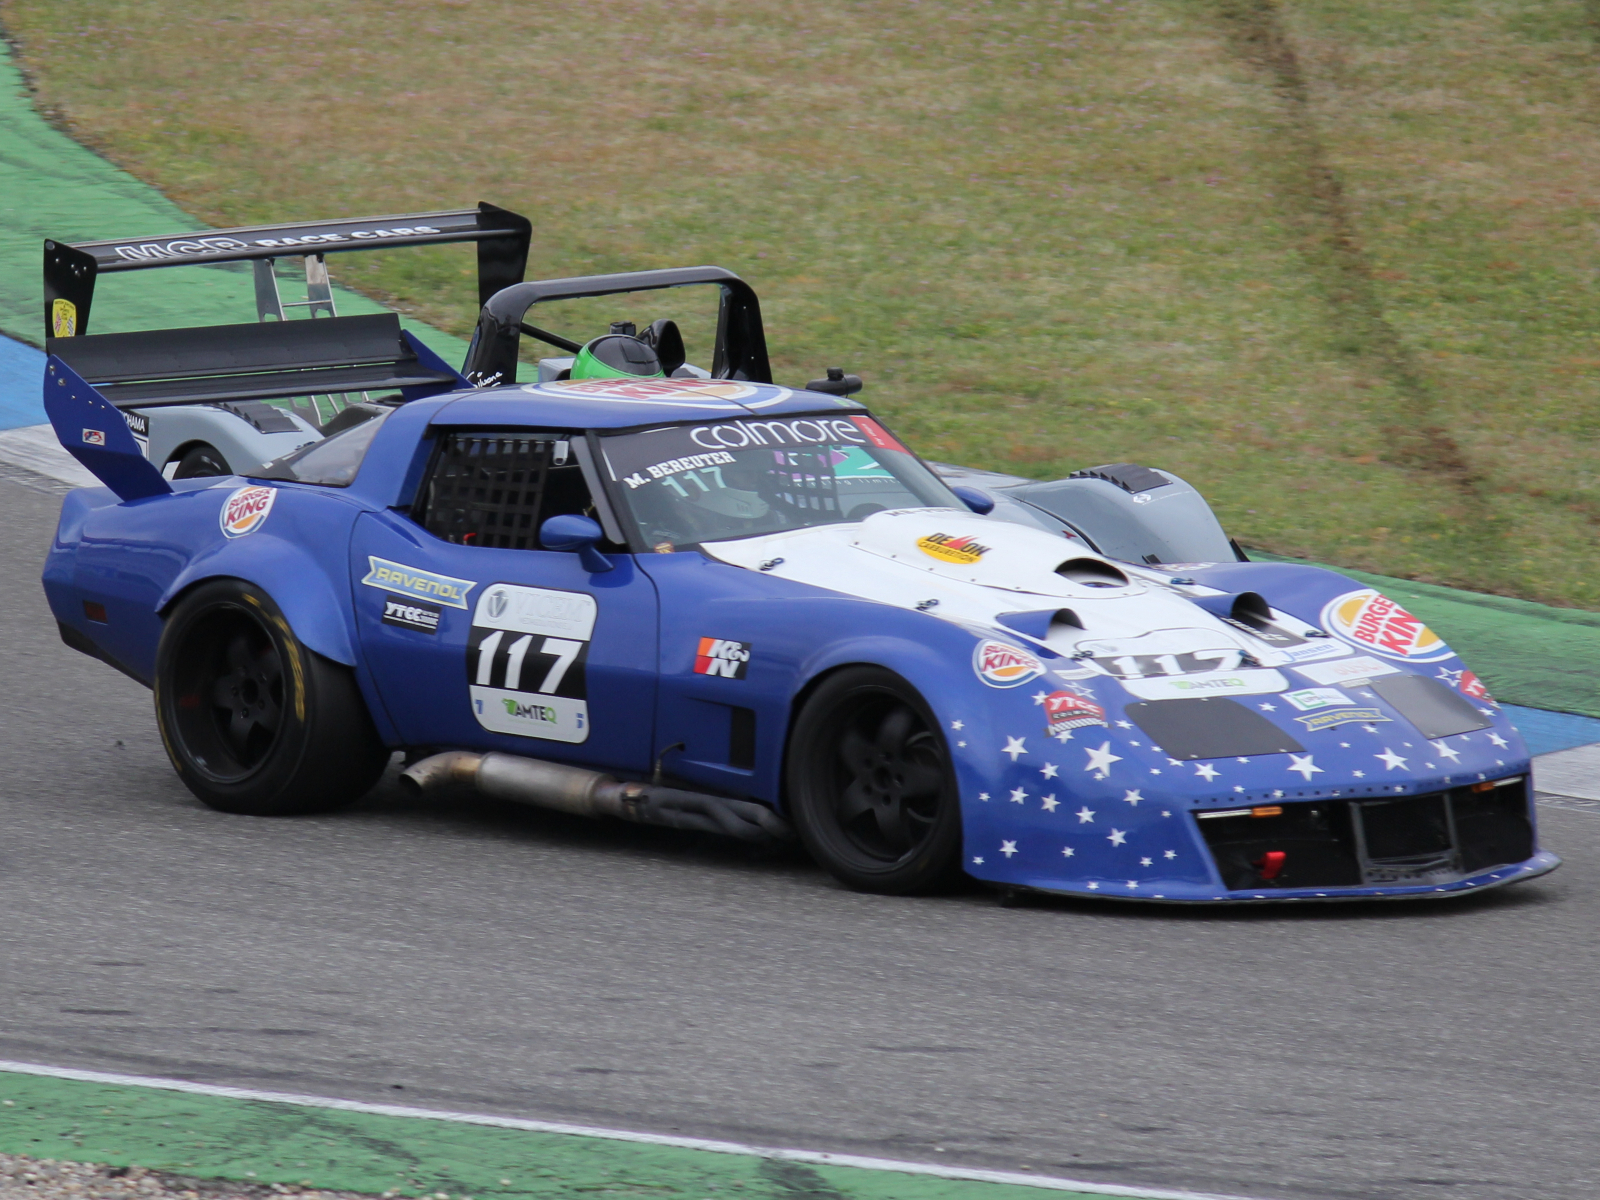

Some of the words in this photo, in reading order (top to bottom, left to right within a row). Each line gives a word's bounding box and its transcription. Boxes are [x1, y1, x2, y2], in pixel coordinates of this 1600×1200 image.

[255, 233, 349, 248] RACE
[351, 226, 441, 240] CARS
[689, 419, 866, 449] colmore
[623, 472, 652, 489] M.
[646, 451, 737, 479] BEREUTER
[661, 466, 727, 498] 117
[224, 495, 270, 528] KING
[375, 566, 461, 600] RAVENOL
[384, 601, 423, 622] YTCC
[1353, 593, 1396, 644] BURGE
[1378, 608, 1423, 657] KIN
[475, 630, 584, 694] 117
[1112, 649, 1244, 680] 117
[1308, 711, 1380, 726] RAVENOL
